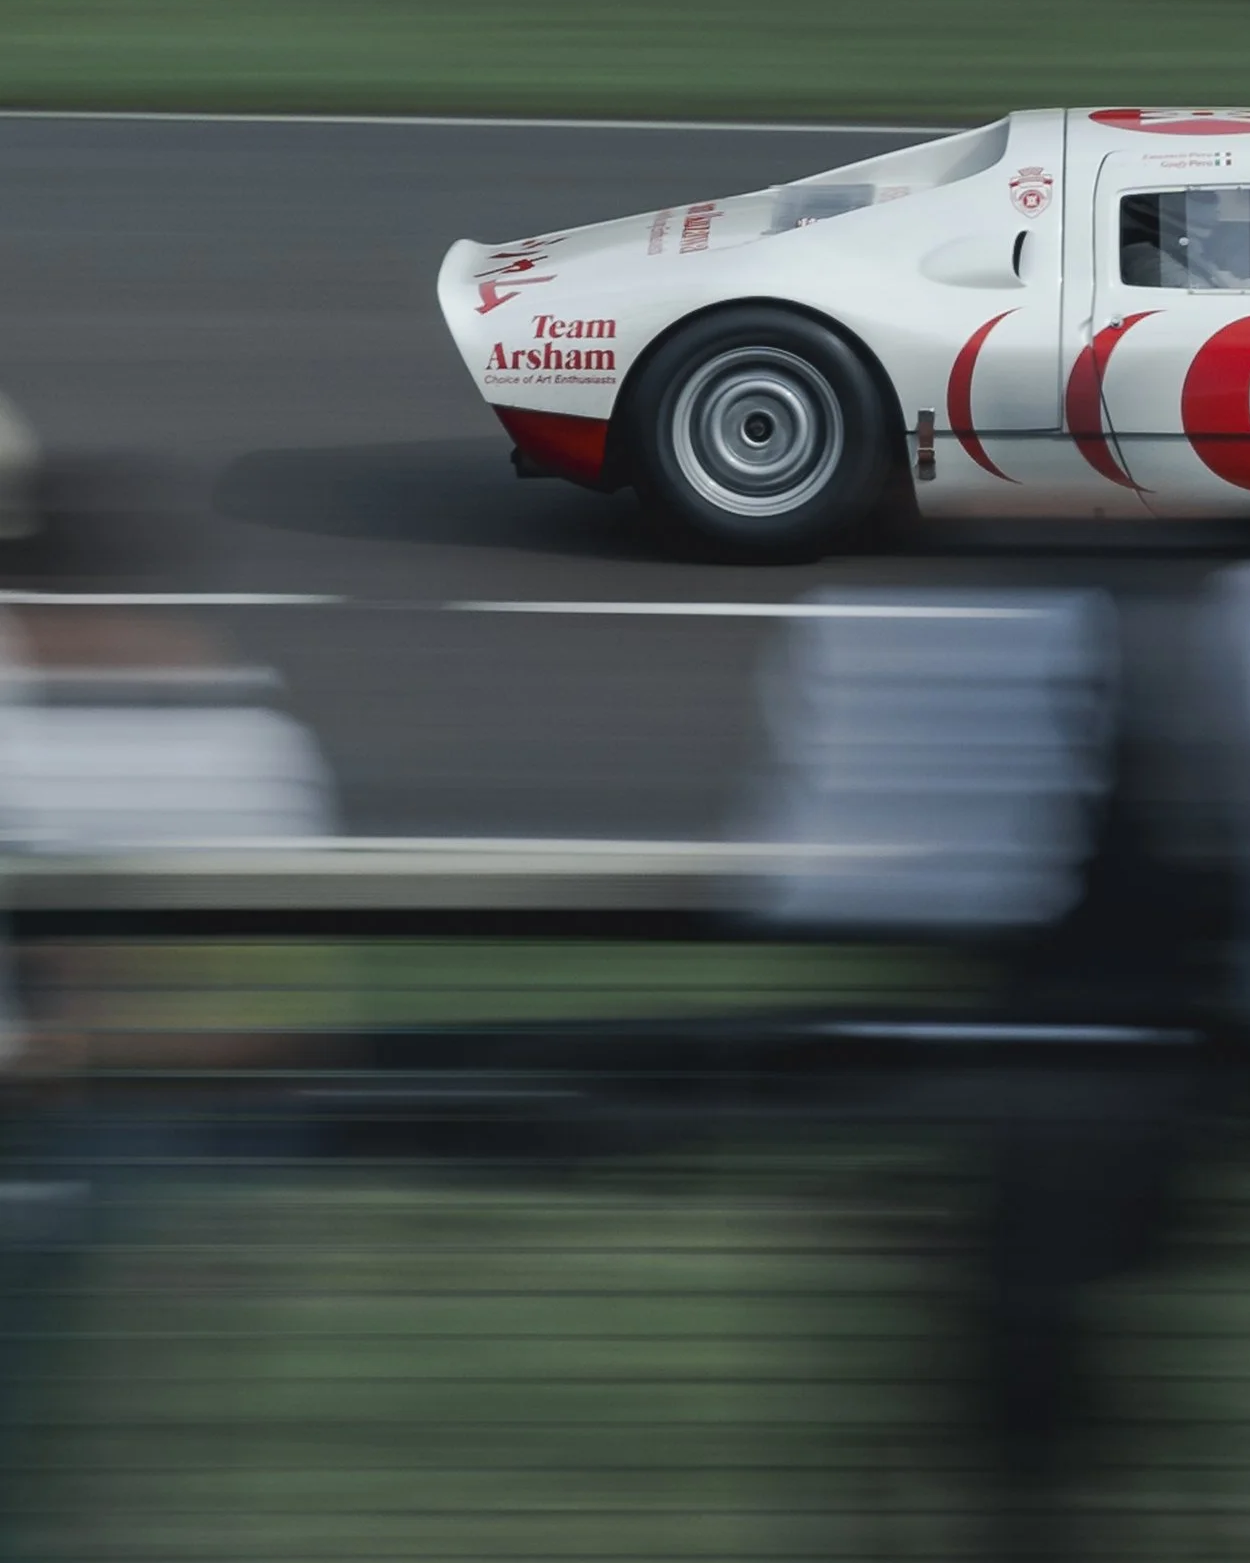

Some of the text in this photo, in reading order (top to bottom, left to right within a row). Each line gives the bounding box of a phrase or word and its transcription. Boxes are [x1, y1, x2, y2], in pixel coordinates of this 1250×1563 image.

[531, 314, 616, 339] Team
[485, 341, 616, 370] Arsham
[484, 374, 617, 385] Choice of Art Enthusiasts
